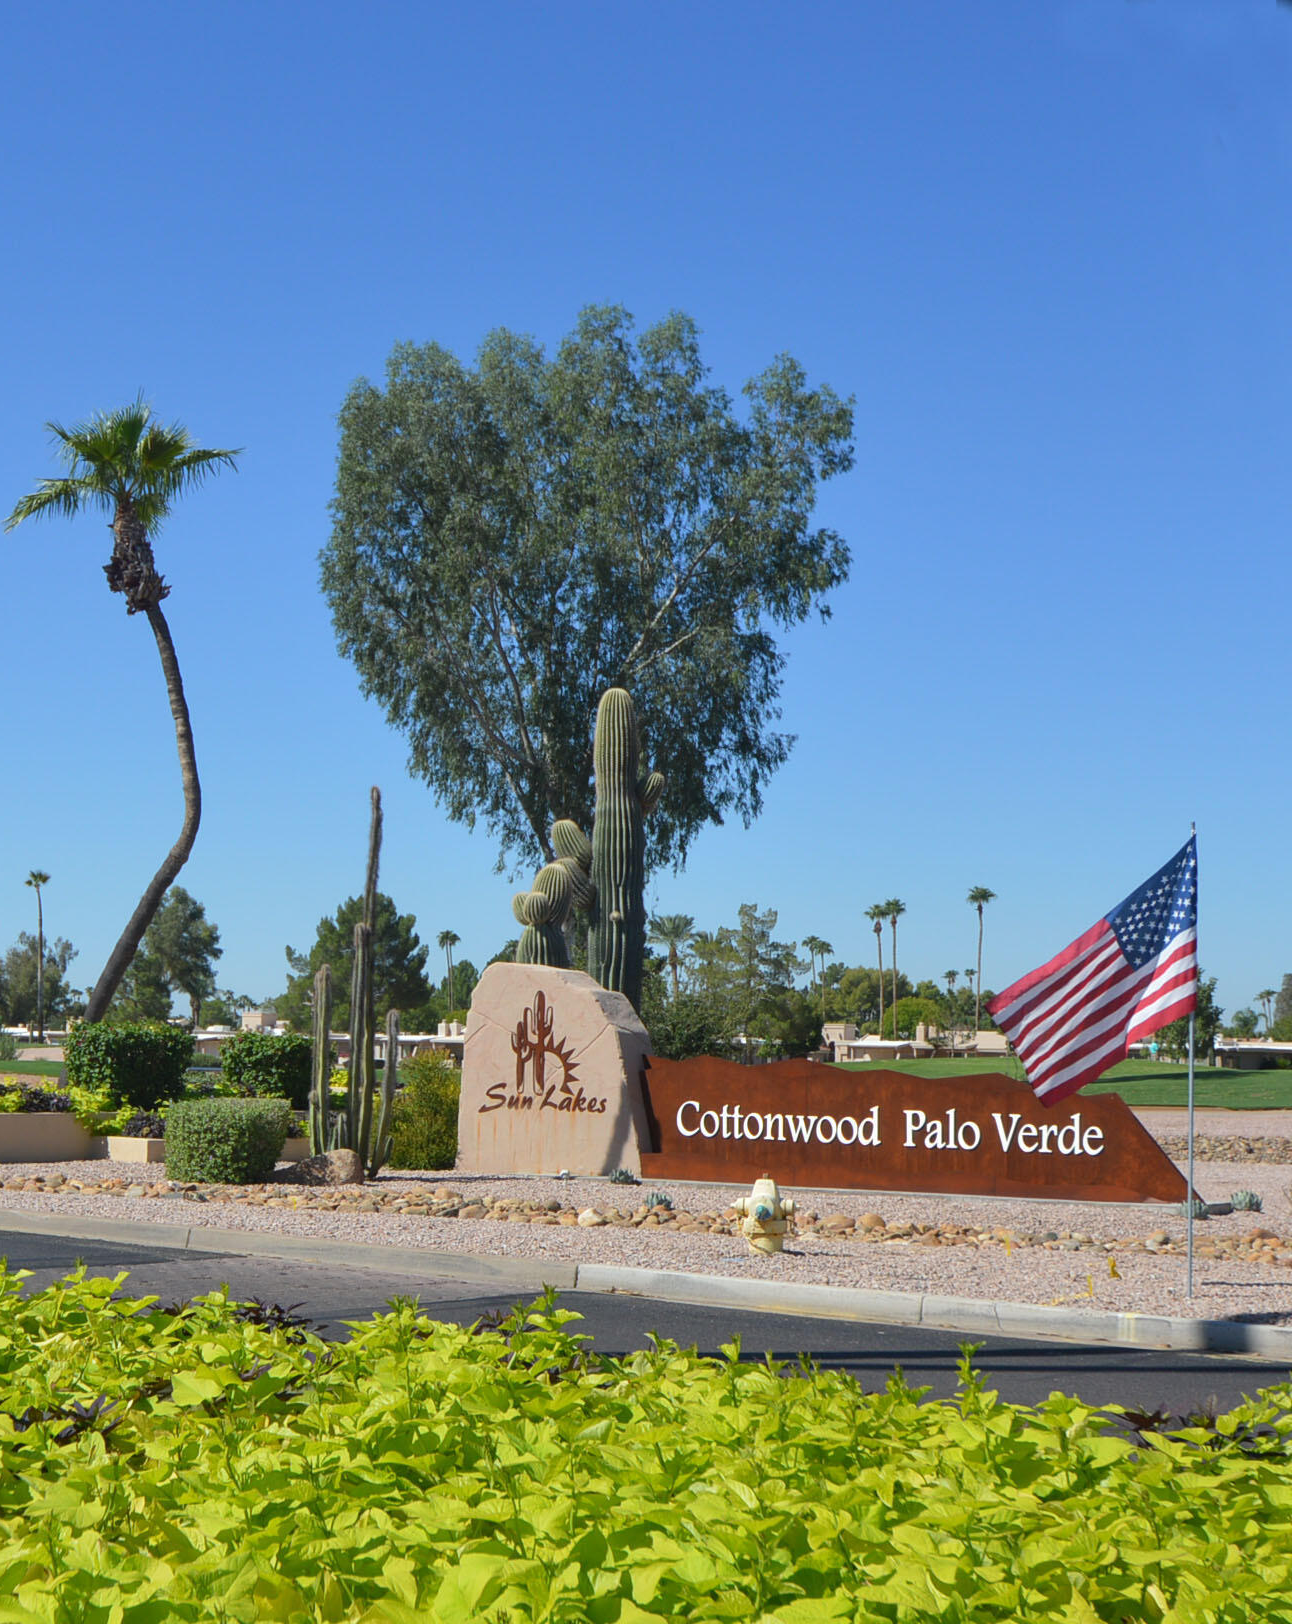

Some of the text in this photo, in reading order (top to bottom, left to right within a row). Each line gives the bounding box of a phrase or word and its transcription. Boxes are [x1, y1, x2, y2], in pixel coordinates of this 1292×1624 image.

[478, 1082, 608, 1114] Sun Lakes
[676, 1100, 1105, 1156] Cottonwood Palo Verde
